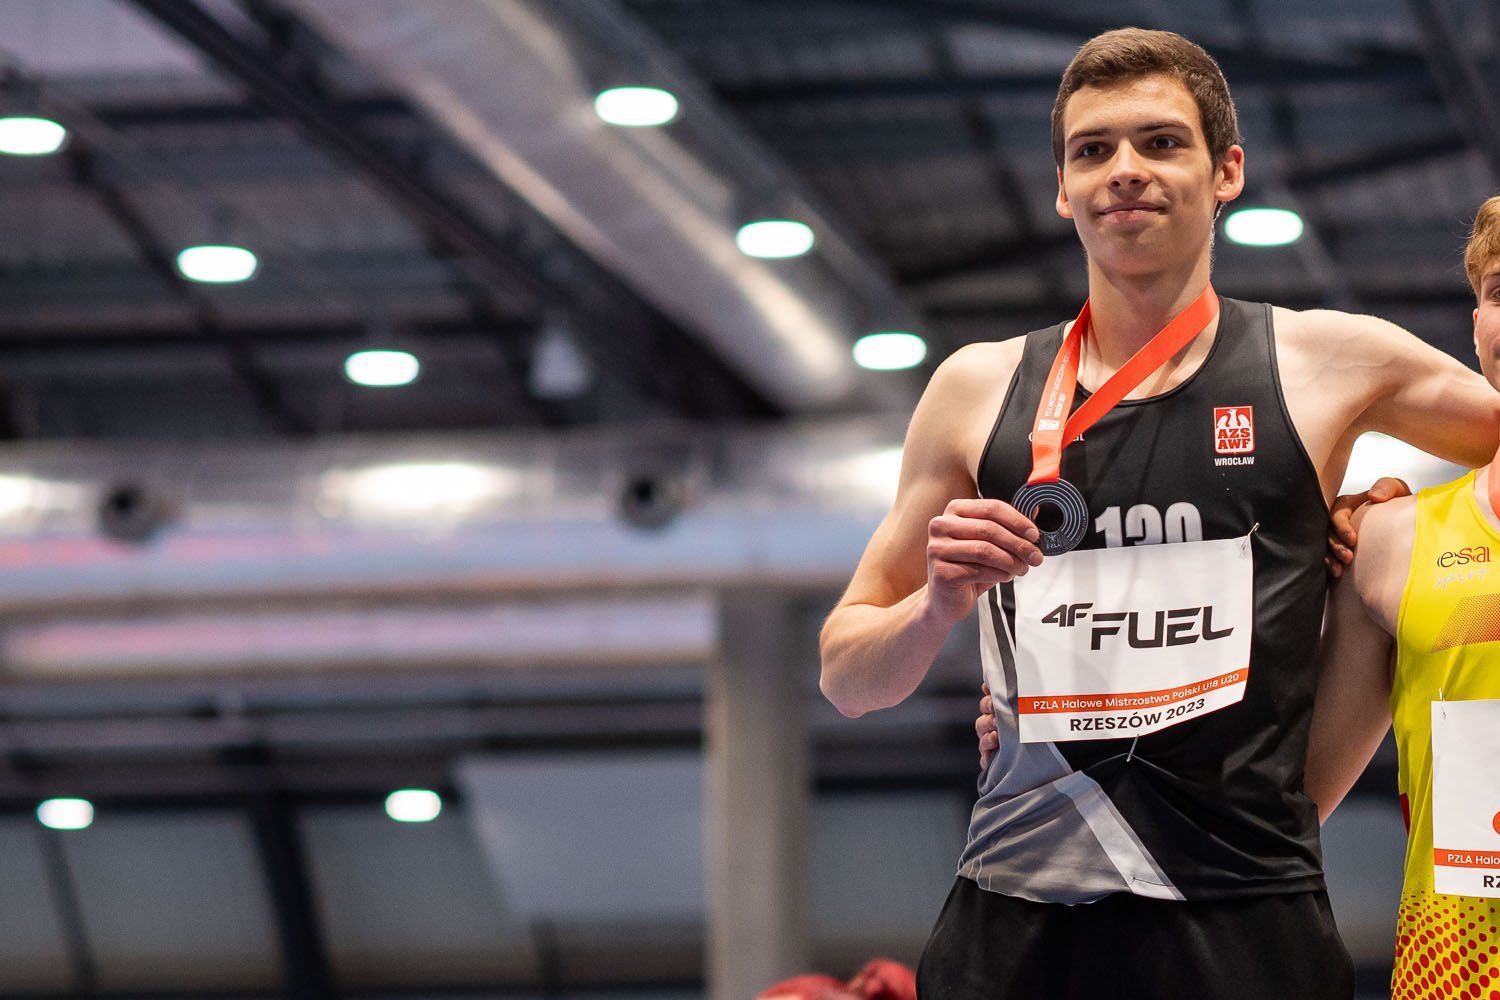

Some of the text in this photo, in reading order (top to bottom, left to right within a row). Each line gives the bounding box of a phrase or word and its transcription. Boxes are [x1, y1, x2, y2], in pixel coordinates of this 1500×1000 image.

[1218, 428, 1251, 439] AZS
[1218, 438, 1251, 449] AWF
[1214, 456, 1255, 467] WROCŁAW
[1041, 602, 1234, 651] 4F FUEL
[1033, 673, 1239, 710] PZLA Halowe Mistrzostwa Polski U18 U20
[1070, 698, 1206, 732] RZESZÓW 2023
[1447, 854, 1473, 864] PZLA
